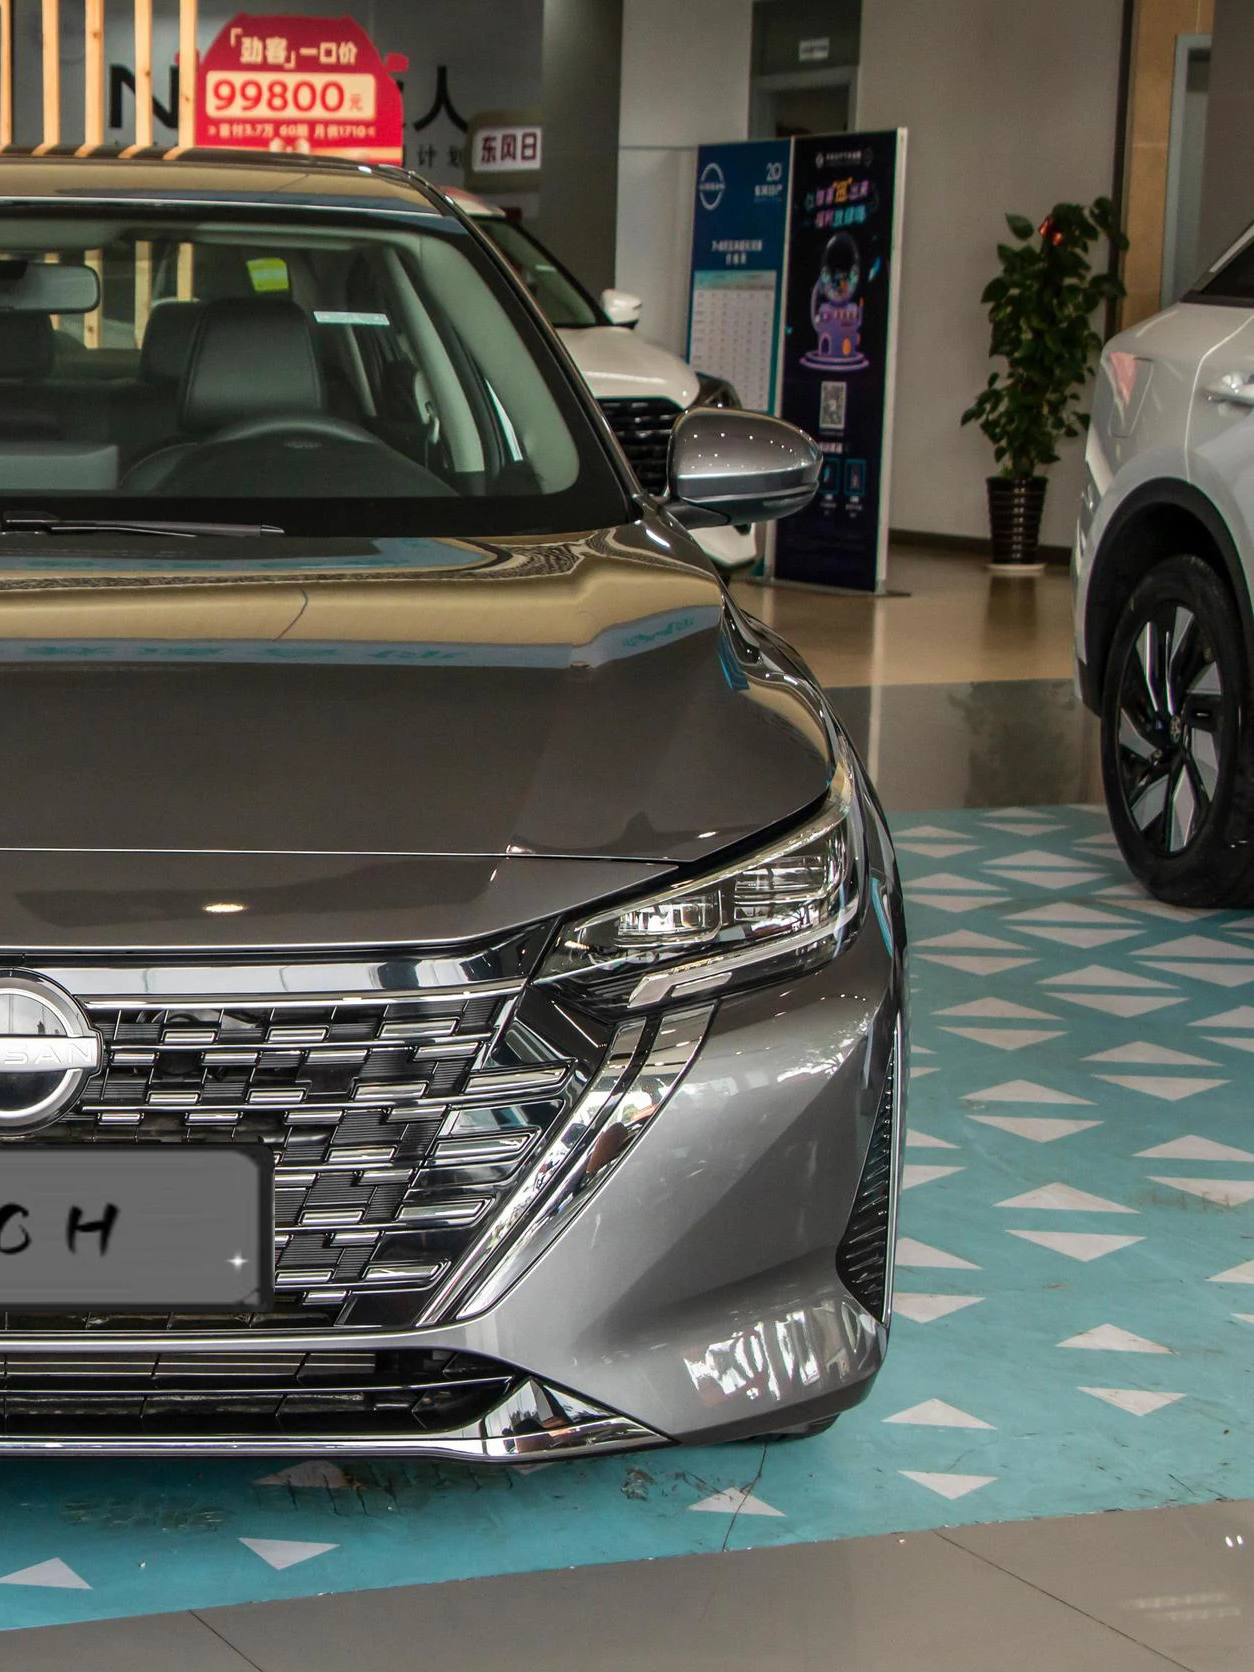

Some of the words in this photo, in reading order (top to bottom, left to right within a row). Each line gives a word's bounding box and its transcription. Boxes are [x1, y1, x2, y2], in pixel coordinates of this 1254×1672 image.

[213, 79, 345, 112] 99800
[349, 93, 363, 110] 元
[413, 65, 468, 132] 人
[481, 132, 537, 163] 东风日
